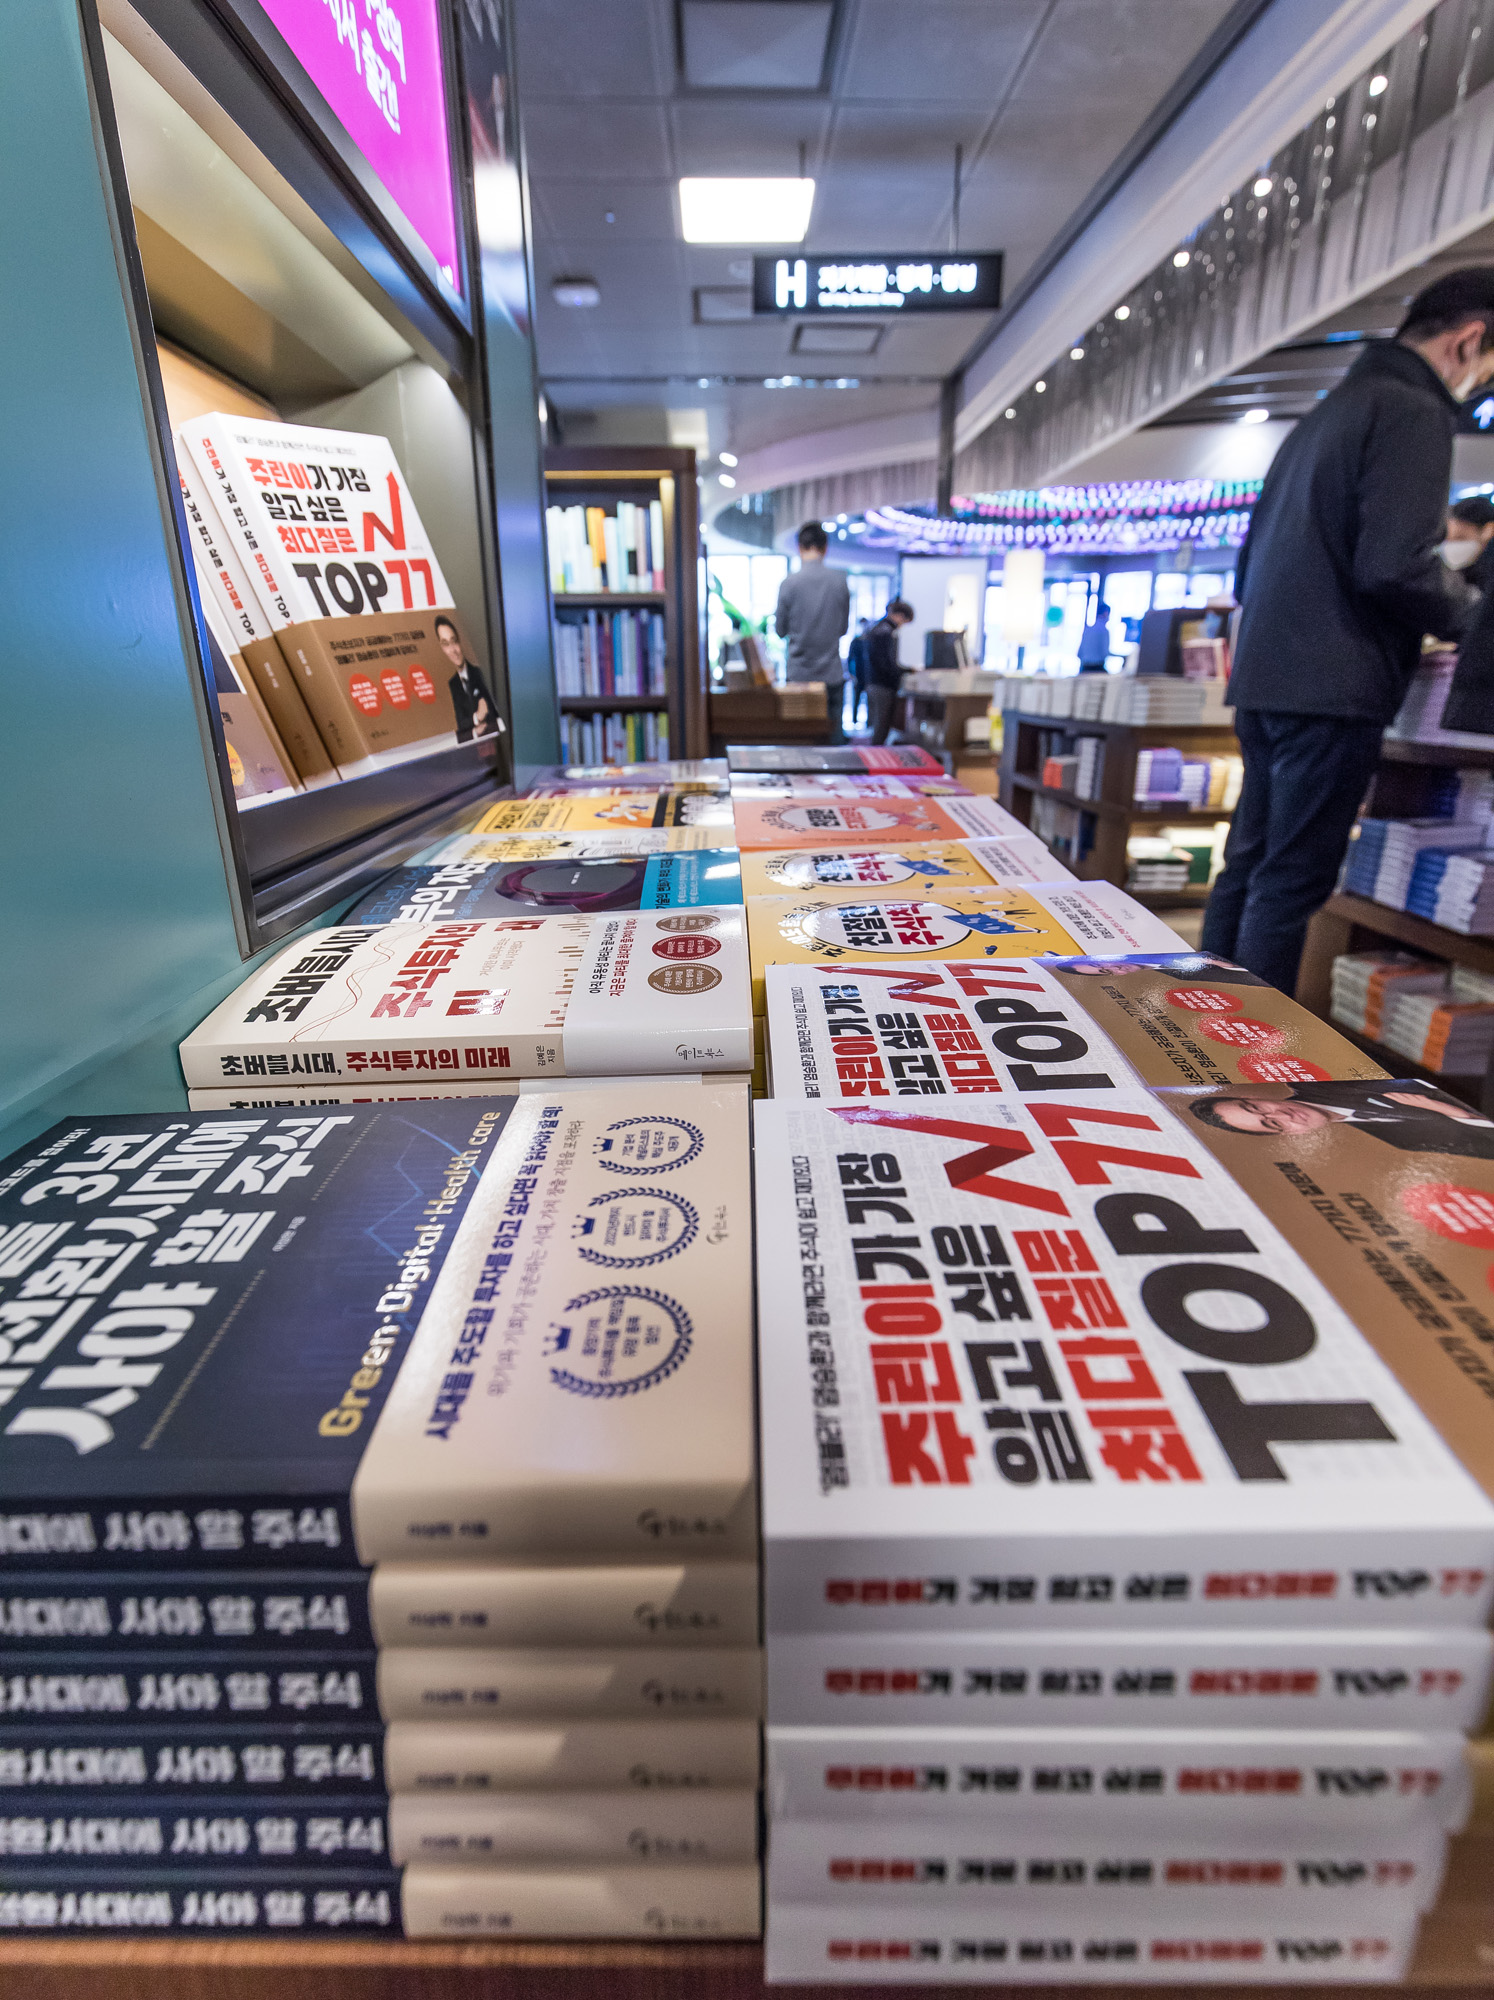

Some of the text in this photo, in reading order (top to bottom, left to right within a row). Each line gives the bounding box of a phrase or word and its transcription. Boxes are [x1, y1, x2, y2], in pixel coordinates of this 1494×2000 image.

[776, 259, 807, 308] H
[246, 457, 330, 490] 주린이가
[261, 491, 347, 522] 알고 싶은
[277, 526, 357, 553] 최다질문
[275, 595, 290, 619] TOP
[239, 613, 255, 636] TOP
[600, 932, 615, 946] 끝나지
[837, 905, 894, 946] 친절한
[883, 903, 945, 946] 주식책
[596, 945, 613, 962] 파티는
[616, 943, 633, 959] 최대한
[370, 922, 487, 1018] 주식투자의
[591, 962, 609, 980] 유동성
[613, 959, 629, 977] 파티를
[588, 980, 605, 994] 아직
[608, 977, 626, 996] 지금은
[792, 1003, 807, 1013] 쉽고
[794, 1013, 808, 1029] 주식이
[797, 1029, 813, 1053] 함께라면
[819, 984, 888, 1096] 주린이가 가장
[1137, 1018, 1174, 1048] 궁금해하는
[1152, 1014, 1217, 1068] 염승환이 친절하게
[220, 1047, 510, 1076] 초버블시대, 주식투자의 미래
[536, 1045, 545, 1067] 김예은
[547, 1048, 555, 1064] 지음
[676, 1044, 724, 1060] 메이트북스
[800, 1053, 818, 1081] 염승환과
[875, 1012, 945, 1095] 알고 싶은
[924, 1013, 1000, 1093] 최다질문
[538, 1119, 559, 1129] 할
[562, 1119, 584, 1149] 포착하라
[38, 1128, 92, 1157] 잡아라!
[213, 1116, 355, 1195] 주식
[524, 1130, 554, 1161] 읽어야
[517, 1163, 543, 1176] 꼭
[553, 1150, 576, 1176] 지점을
[791, 1155, 812, 1194] 재미있다
[503, 1177, 537, 1216] 싶다면
[539, 1198, 561, 1219] 가치
[795, 1196, 817, 1219] 쉽고
[150, 1209, 277, 1267] 할
[491, 1218, 522, 1249] 하고
[797, 1221, 819, 1260] 주식이
[0, 1119, 268, 1405] 전환시대에
[472, 1252, 512, 1302] 투자를
[802, 1264, 830, 1326] 함께라면
[503, 1301, 532, 1344] 기회가
[837, 1152, 971, 1483] 주린이가 가장
[450, 1307, 494, 1365] 주도할
[5, 1282, 219, 1455] 사야
[807, 1330, 839, 1407] 염승환과
[931, 1224, 1089, 1483] 알고 싶은
[1015, 1230, 1196, 1480] 최다질문
[426, 1371, 474, 1439] 시대를
[1353, 1569, 1430, 1597] TOP
[1332, 1669, 1408, 1694] TOP
[1315, 1767, 1388, 1793] TOP
[1297, 1858, 1366, 1885] TOP
[1276, 1938, 1342, 1962] TOP
